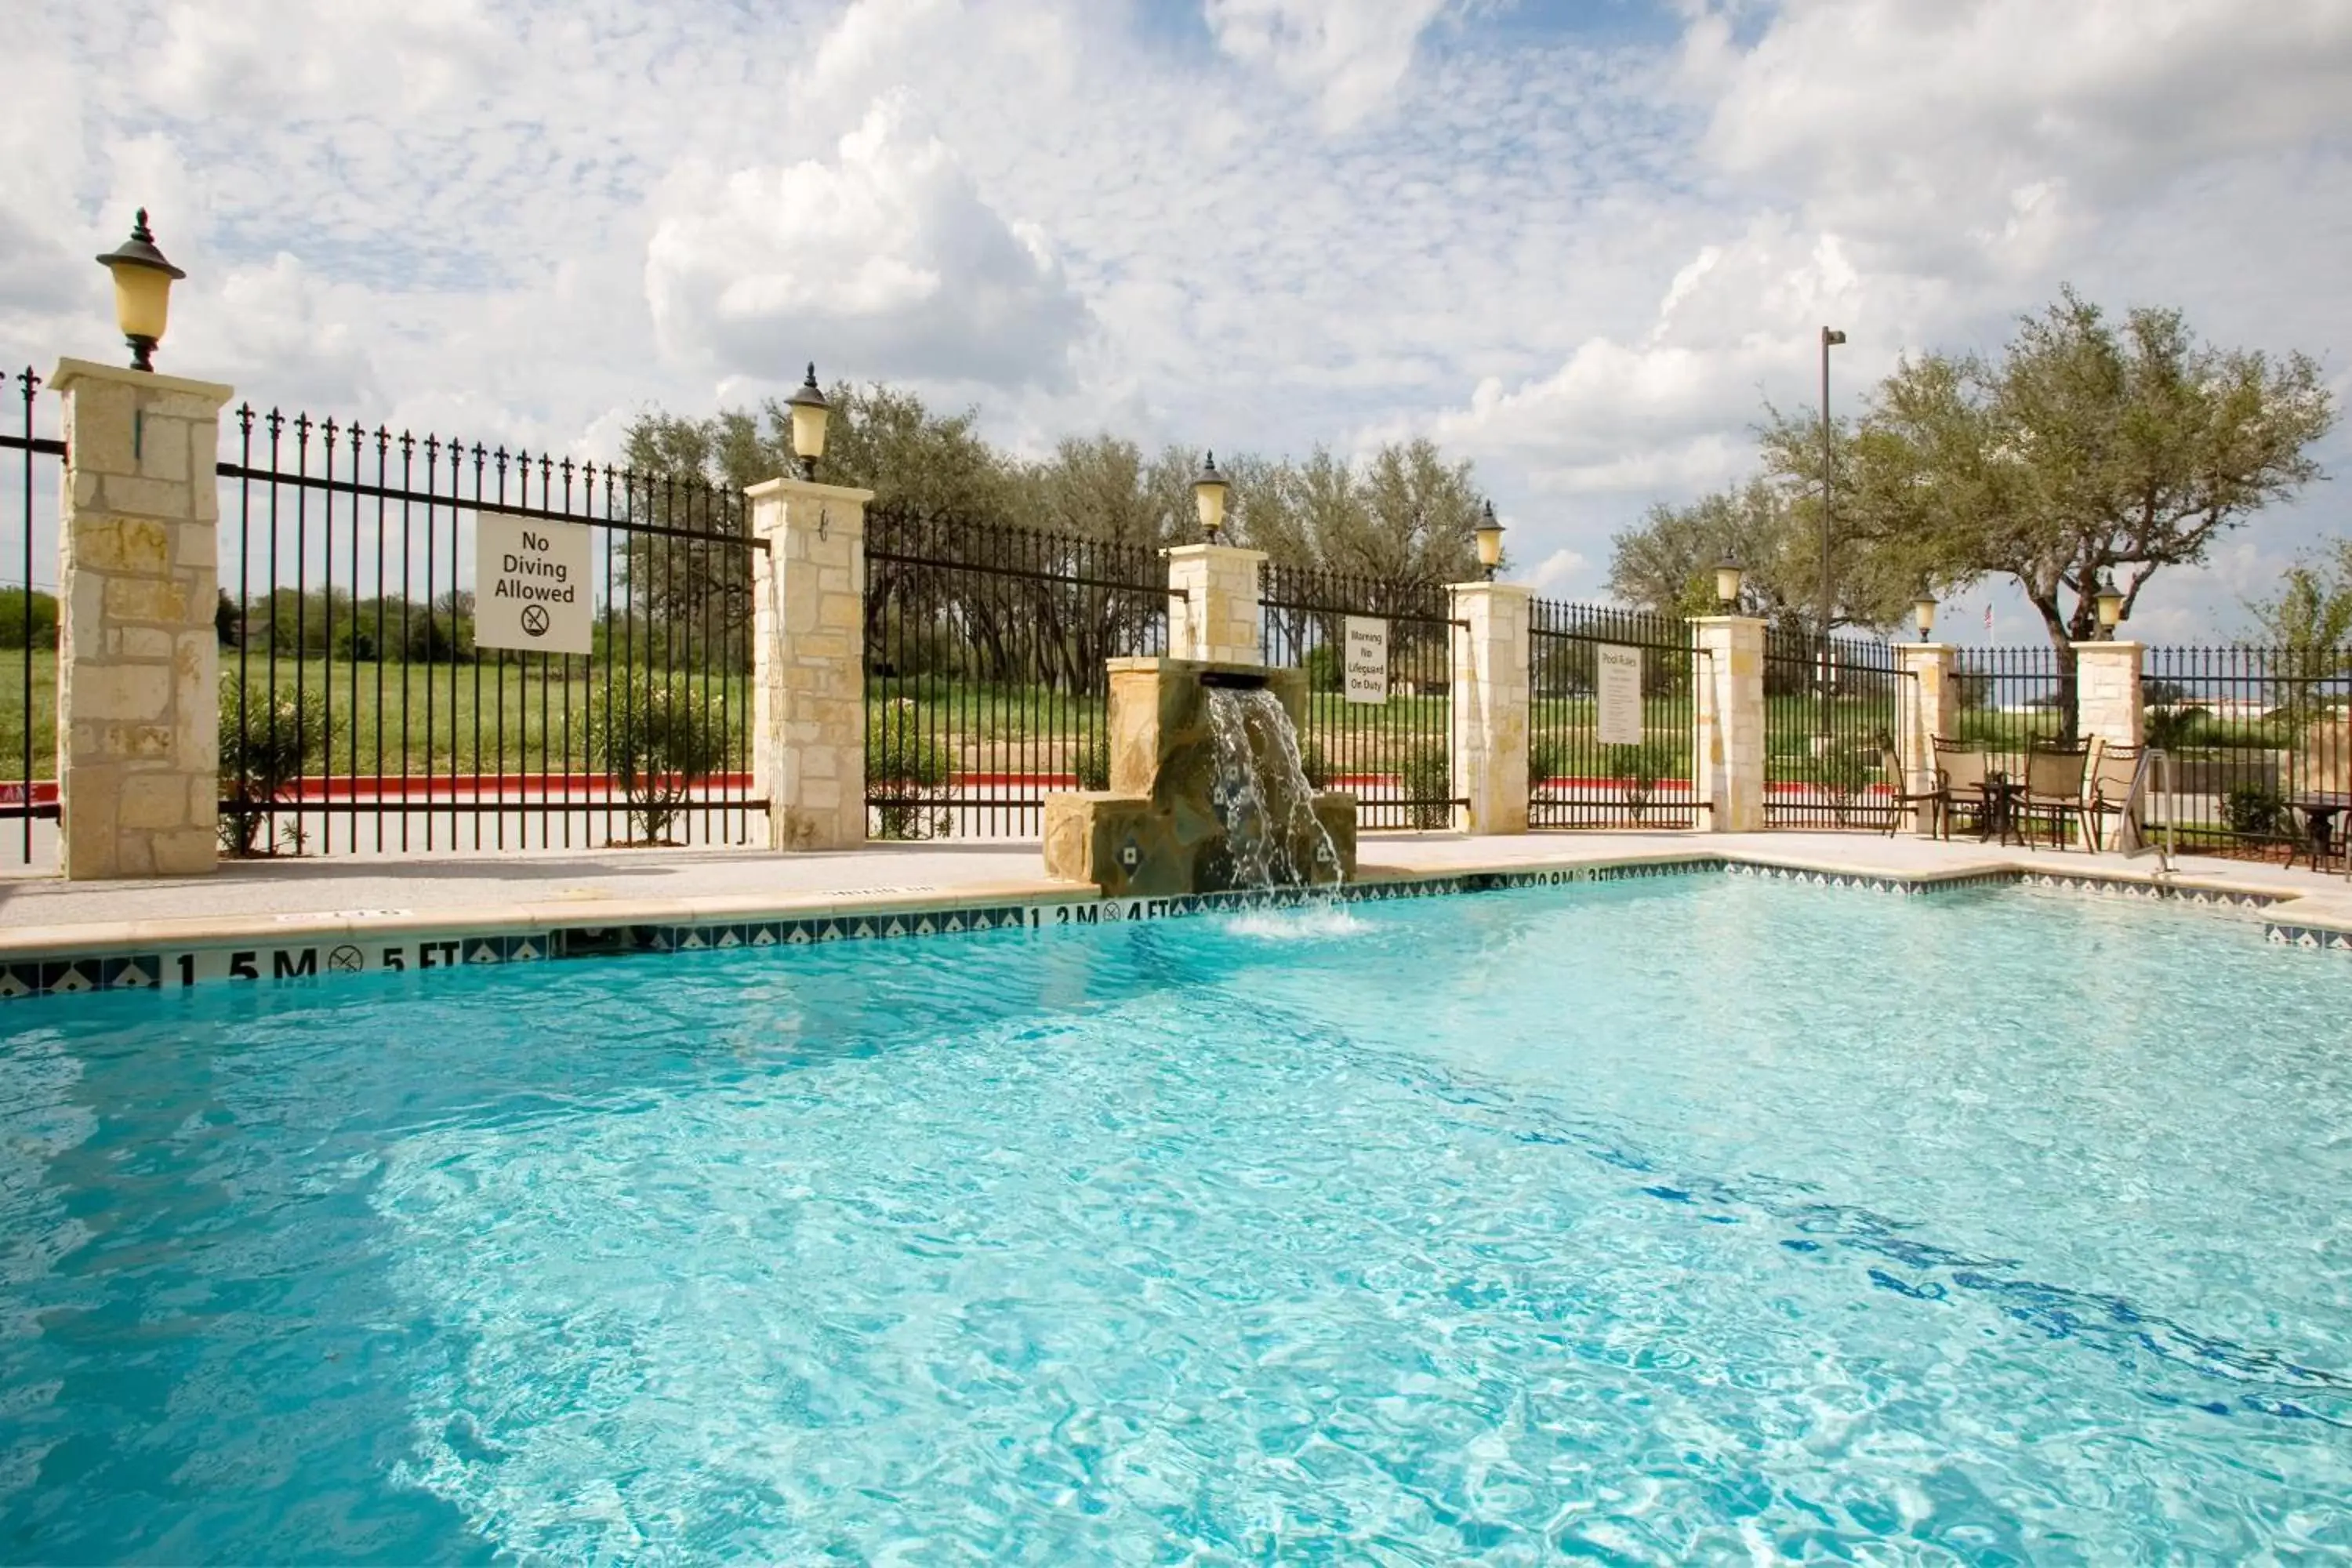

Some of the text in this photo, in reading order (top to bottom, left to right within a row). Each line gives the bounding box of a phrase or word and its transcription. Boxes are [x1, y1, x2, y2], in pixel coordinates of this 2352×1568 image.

[522, 532, 550, 551] No
[503, 554, 567, 582] Diving
[495, 579, 575, 603] Allowed
[1351, 630, 1381, 645] Warning
[1360, 647, 1372, 657] No
[1348, 662, 1384, 675] Lifeguard
[1351, 678, 1381, 693] On Duty
[419, 941, 460, 969] FT
